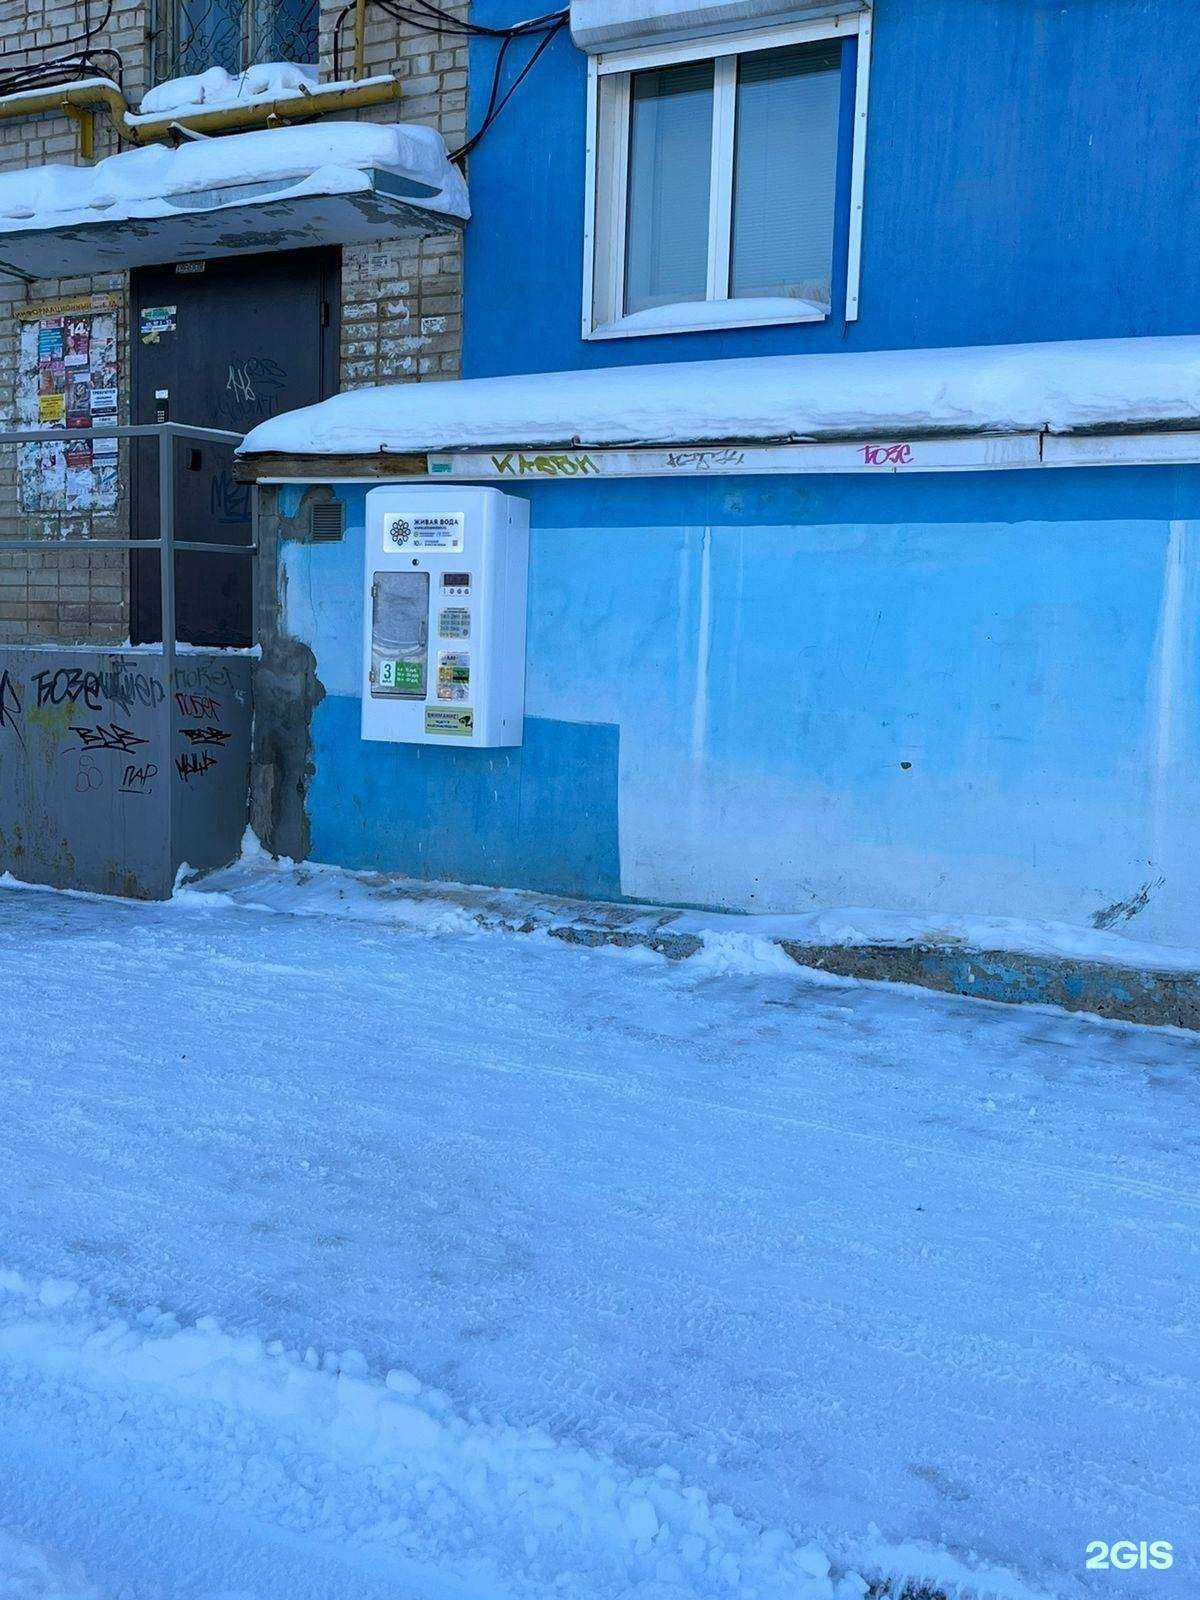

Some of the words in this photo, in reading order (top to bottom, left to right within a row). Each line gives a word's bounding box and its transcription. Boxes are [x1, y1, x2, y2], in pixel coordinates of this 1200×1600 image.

[414, 518, 438, 526] ЖИВАЯ
[440, 518, 459, 527] ВОДА
[384, 663, 391, 679] 3
